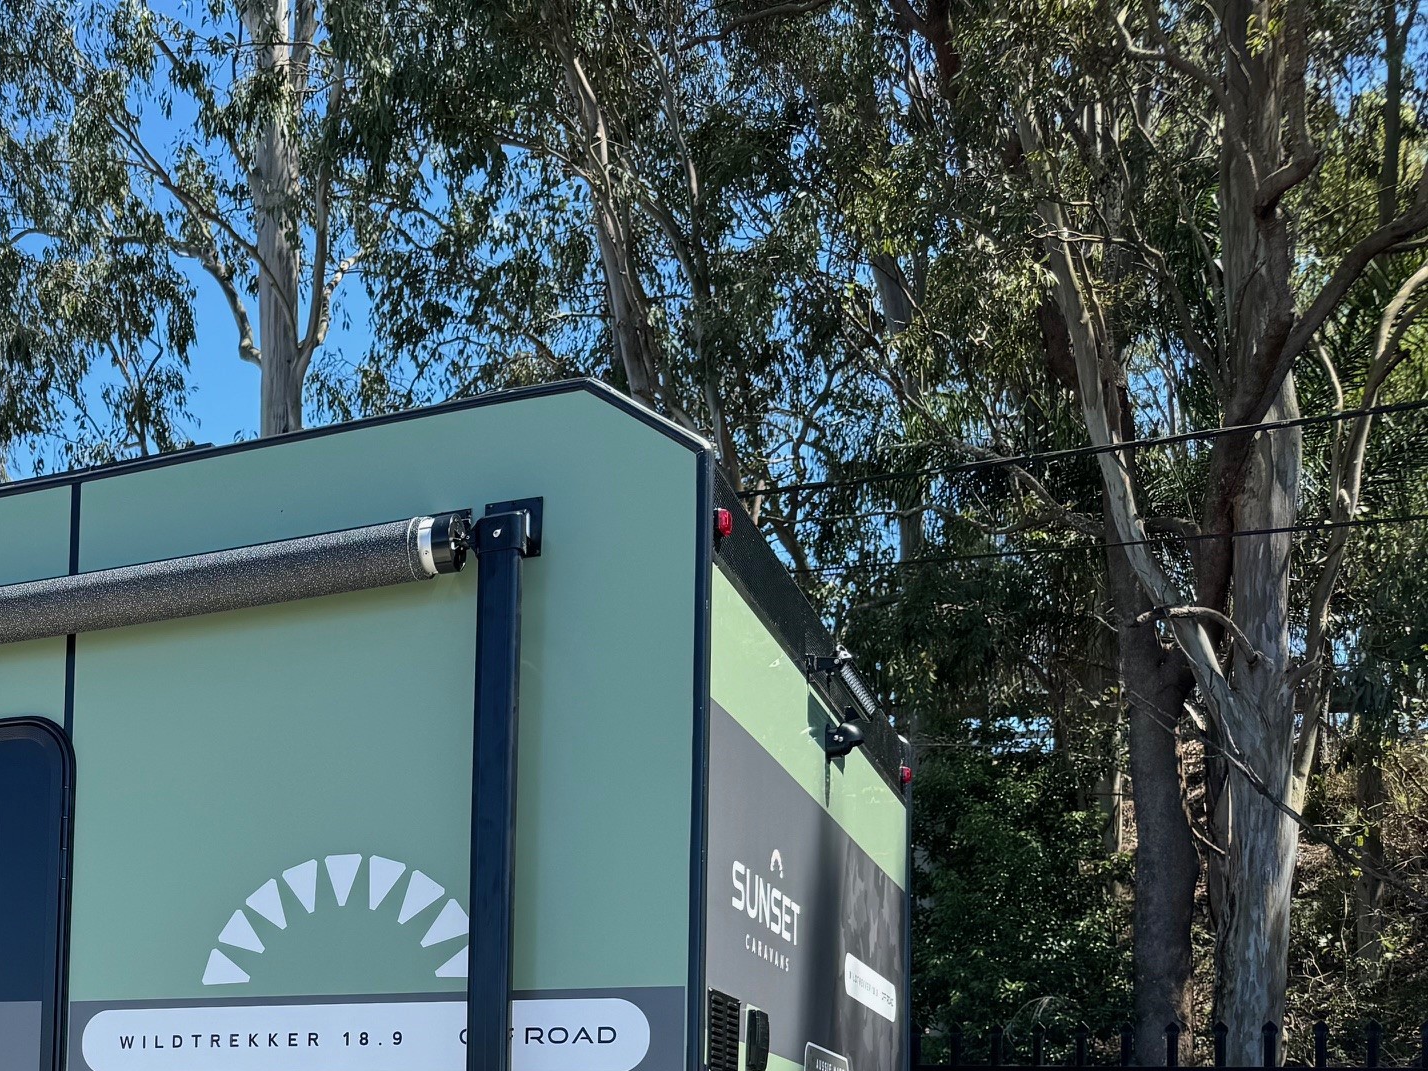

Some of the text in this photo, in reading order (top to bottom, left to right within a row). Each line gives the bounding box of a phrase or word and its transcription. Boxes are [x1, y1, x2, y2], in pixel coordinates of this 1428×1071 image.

[732, 860, 801, 946] SUNSET
[745, 933, 790, 972] CARAVANS
[119, 1031, 404, 1050] WILDTREKKER 18.9
[524, 1026, 618, 1045] ROAD
